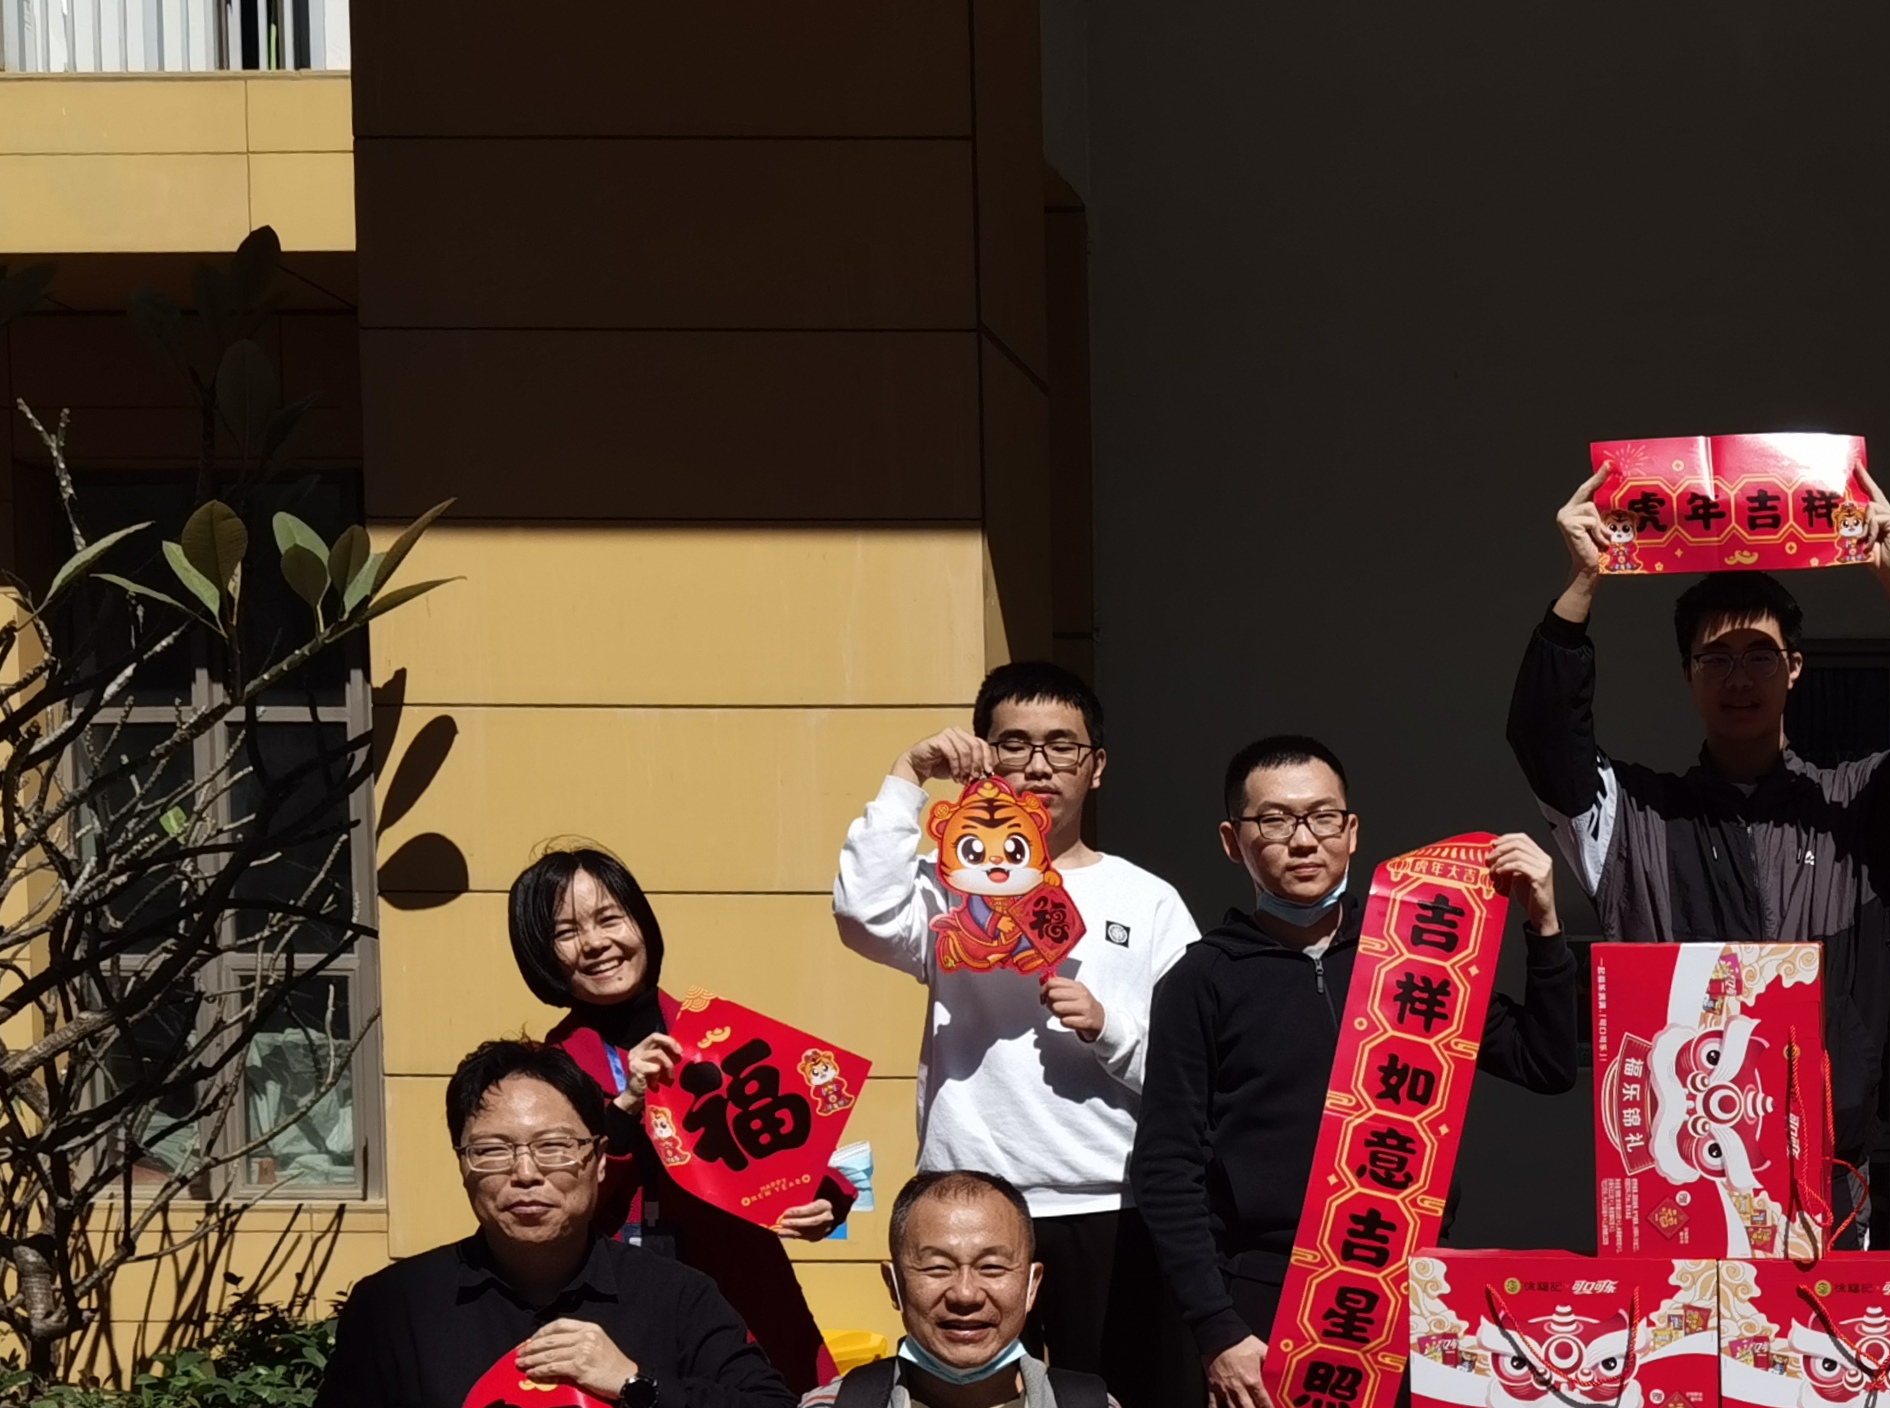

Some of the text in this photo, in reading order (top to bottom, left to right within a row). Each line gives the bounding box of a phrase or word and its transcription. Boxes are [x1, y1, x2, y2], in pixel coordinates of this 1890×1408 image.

[1627, 489, 1840, 534] 虎年吉祥
[1414, 860, 1477, 883] 虎年大吉
[1029, 895, 1070, 943] 福
[679, 1037, 812, 1172] 福
[1622, 1057, 1645, 1153] 福乐锦礼
[750, 1178, 802, 1202] NEW YEAR
[760, 1178, 787, 1192] HAPPY
[1571, 1279, 1619, 1294] 可口可乐
